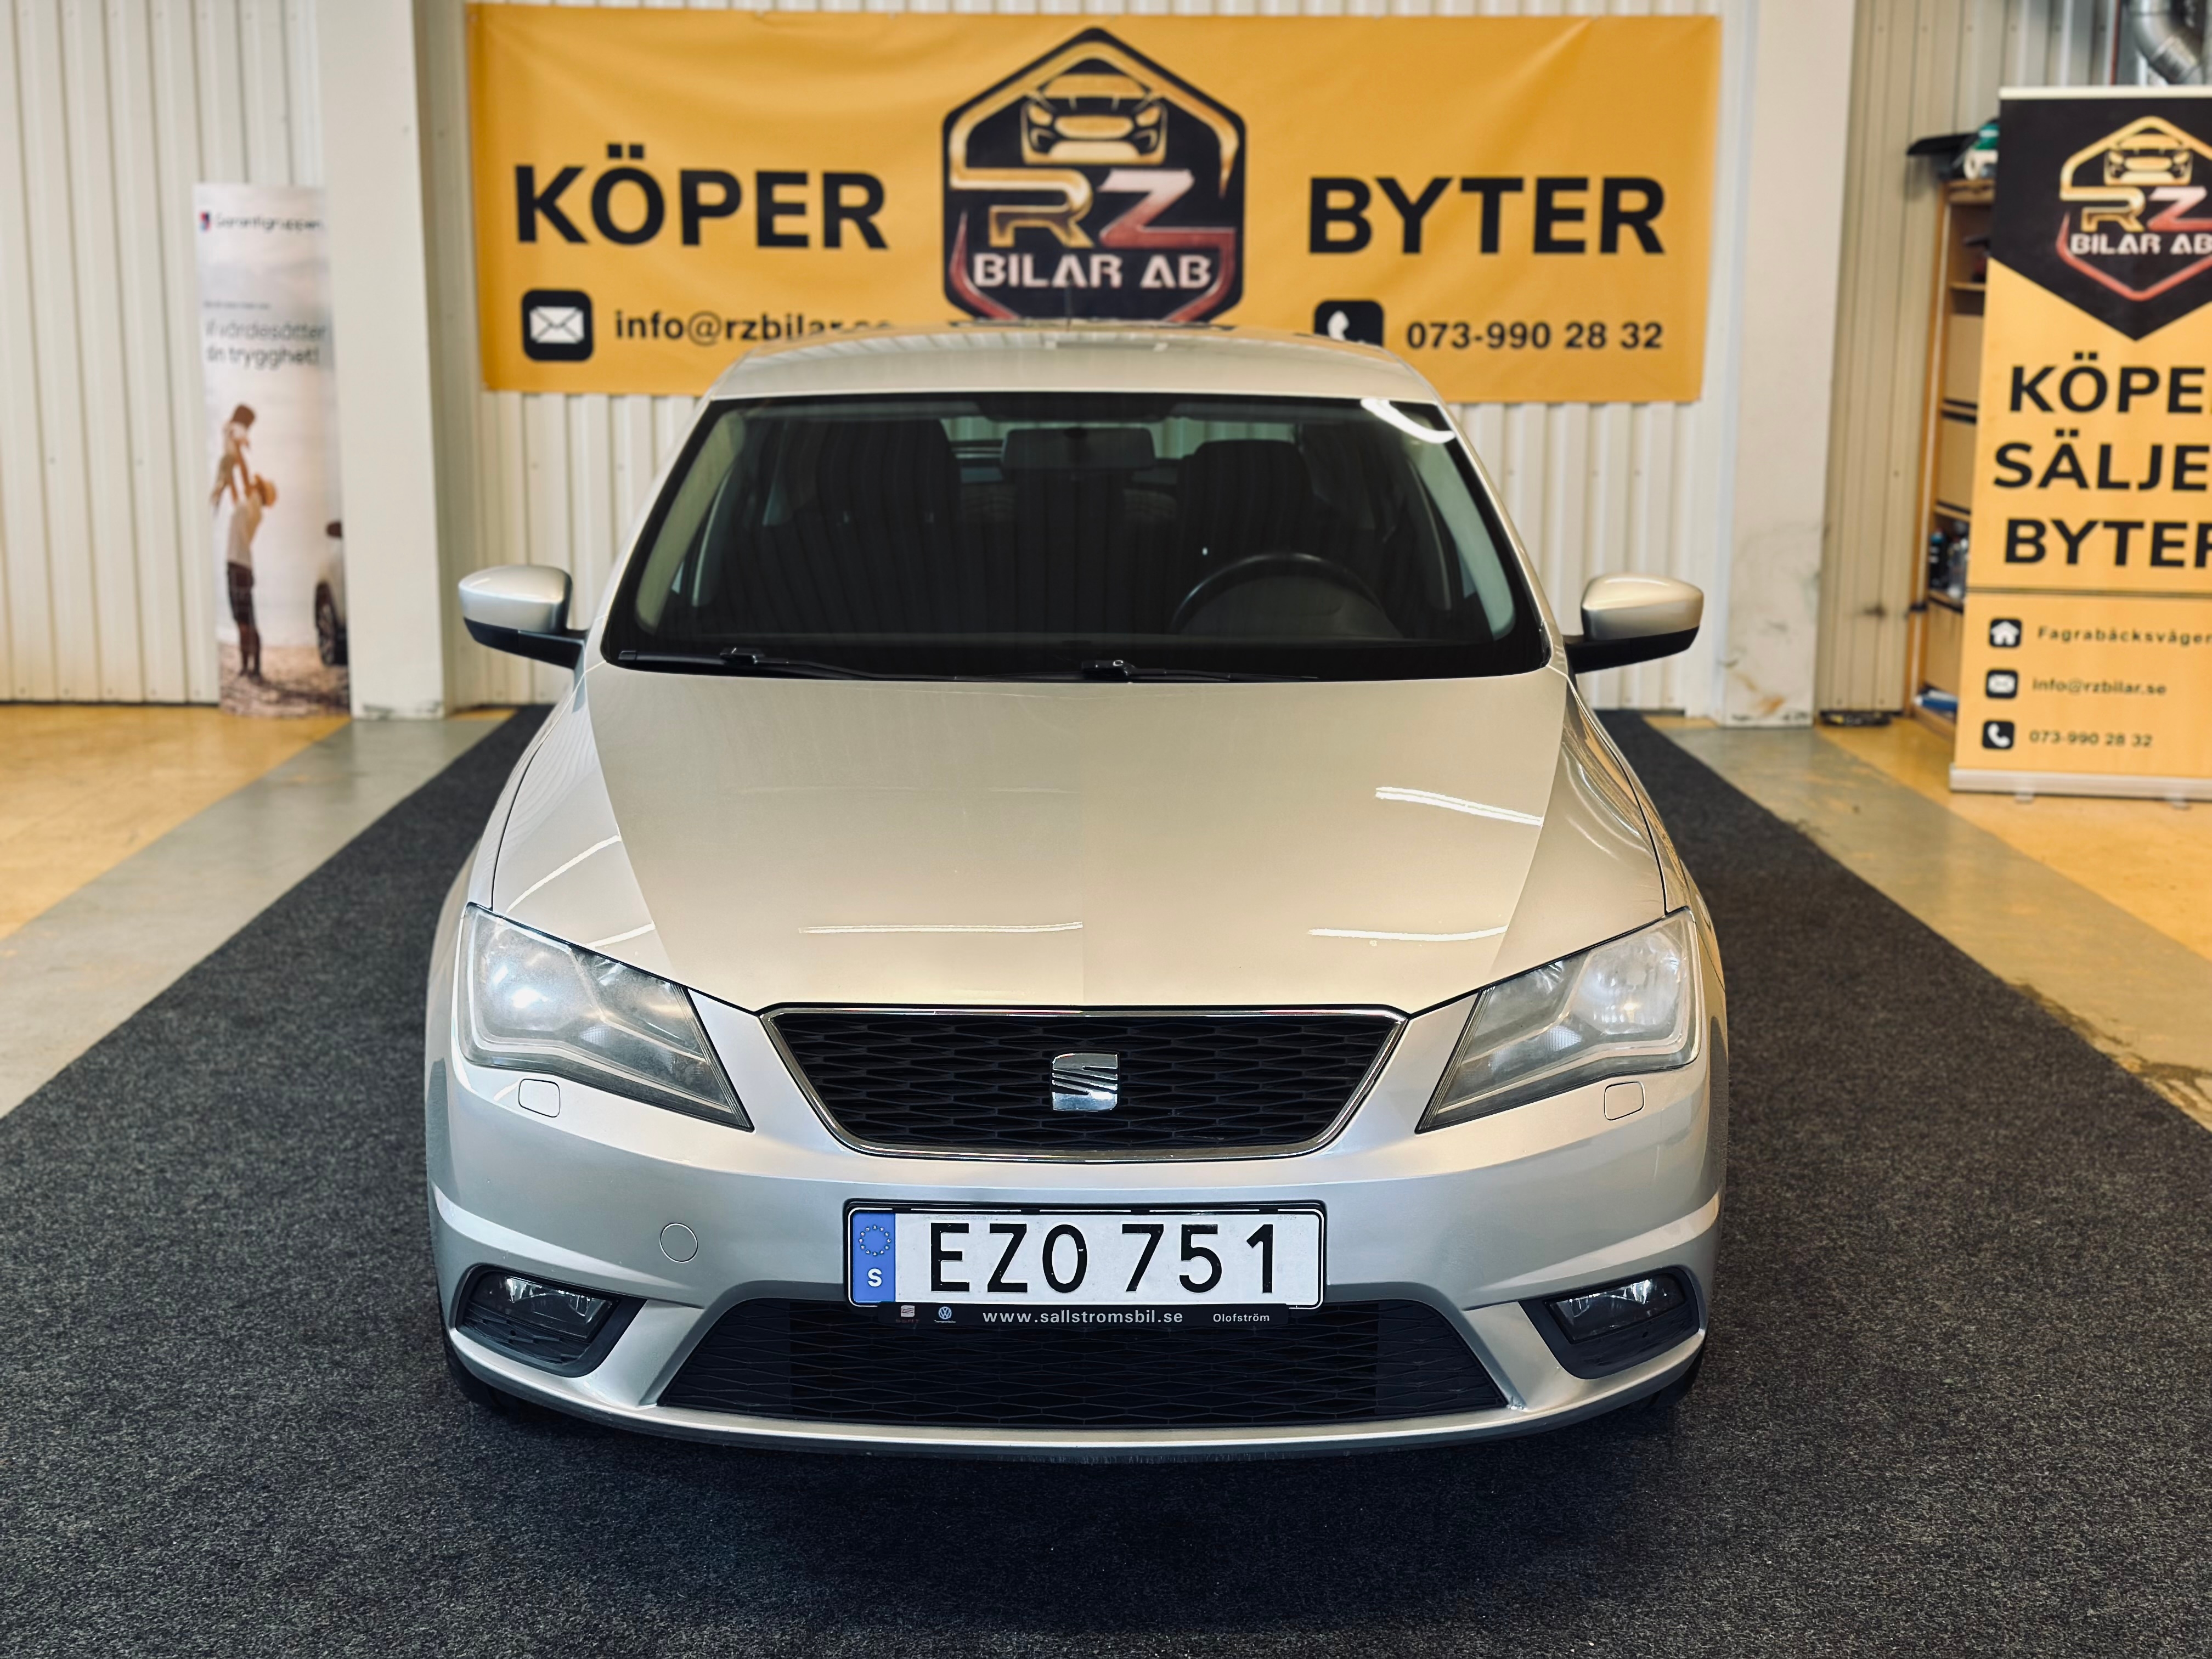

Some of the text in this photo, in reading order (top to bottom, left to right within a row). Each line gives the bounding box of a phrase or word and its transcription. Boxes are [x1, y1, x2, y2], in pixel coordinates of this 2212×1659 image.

[515, 143, 890, 250] KÖPER
[950, 168, 1235, 249] RZ
[1308, 176, 1667, 255] BYTER
[2070, 233, 2212, 255] BILAR AB
[973, 253, 1212, 289] BILAR AB
[614, 310, 895, 347] info@rzbilar
[1406, 321, 1664, 350] 073-990 28 32
[2010, 352, 2212, 414] KÖPE
[1993, 429, 2212, 490] SÄLJE
[2033, 678, 2166, 696] info@rzbilar.se
[2029, 730, 2152, 747] 073-990 28 32
[930, 1222, 1274, 1294] EZO 751
[867, 1268, 882, 1288] S
[983, 1309, 1183, 1323] www.sallstromsbil.se
[1213, 1313, 1270, 1322] Olofström
